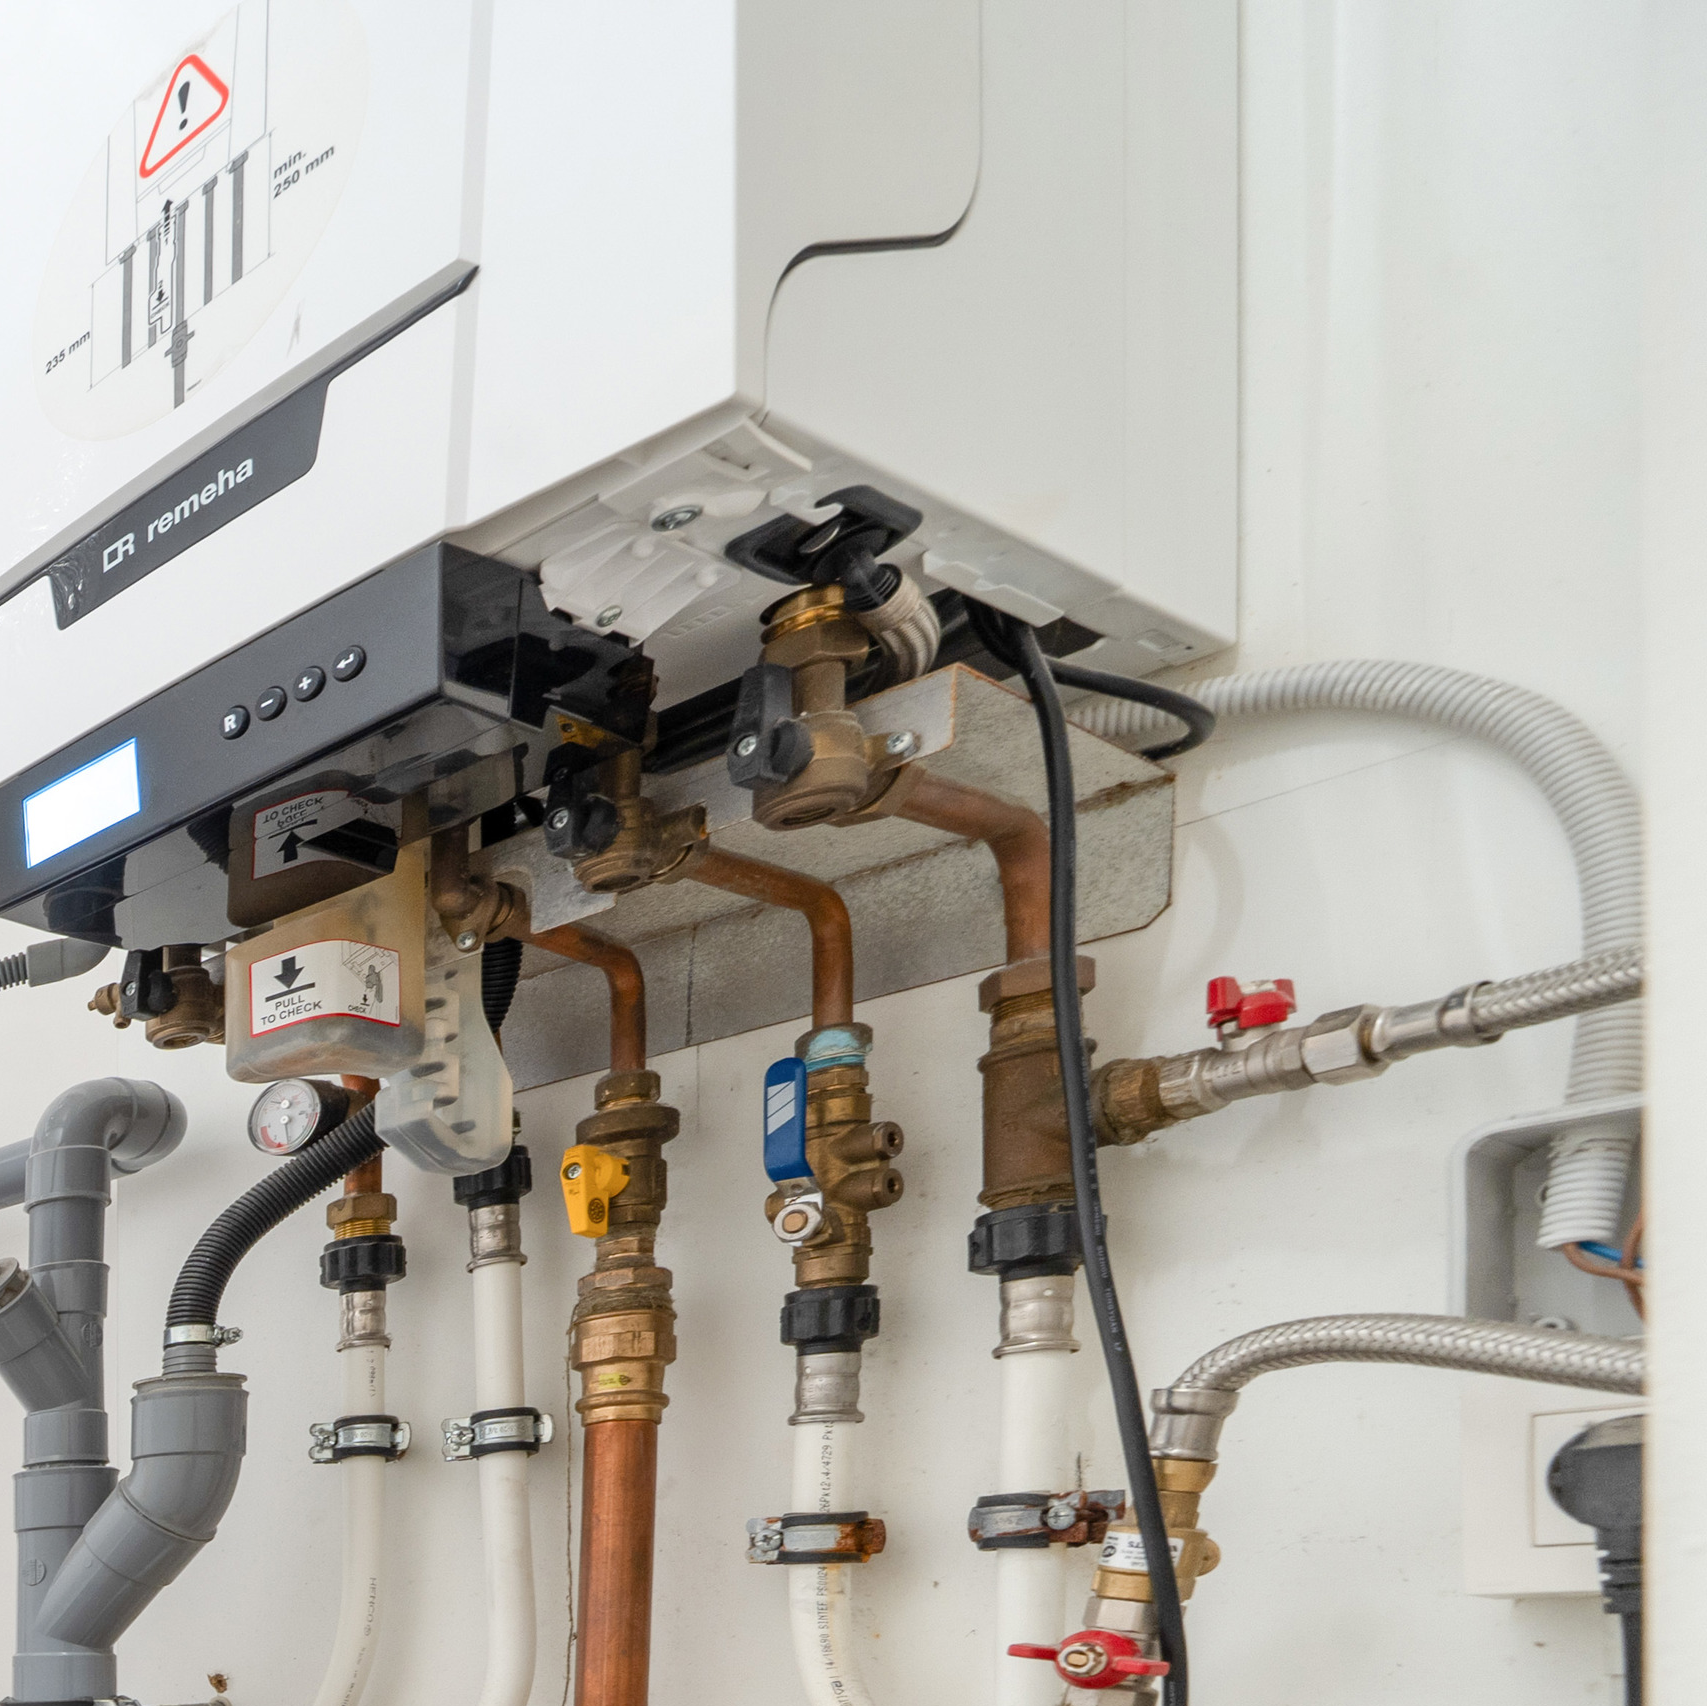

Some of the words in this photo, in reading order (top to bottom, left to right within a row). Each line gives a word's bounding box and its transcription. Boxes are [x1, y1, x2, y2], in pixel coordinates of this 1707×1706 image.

[273, 151, 307, 179] min.
[273, 169, 300, 199] 250
[305, 146, 335, 174] mm
[45, 349, 65, 375] 235
[68, 331, 90, 354] mm
[147, 458, 253, 543] remeha
[223, 713, 237, 732] R
[261, 1016, 276, 1026] TO
[279, 1000, 323, 1020] CHECK
[274, 994, 305, 1011] PULL
